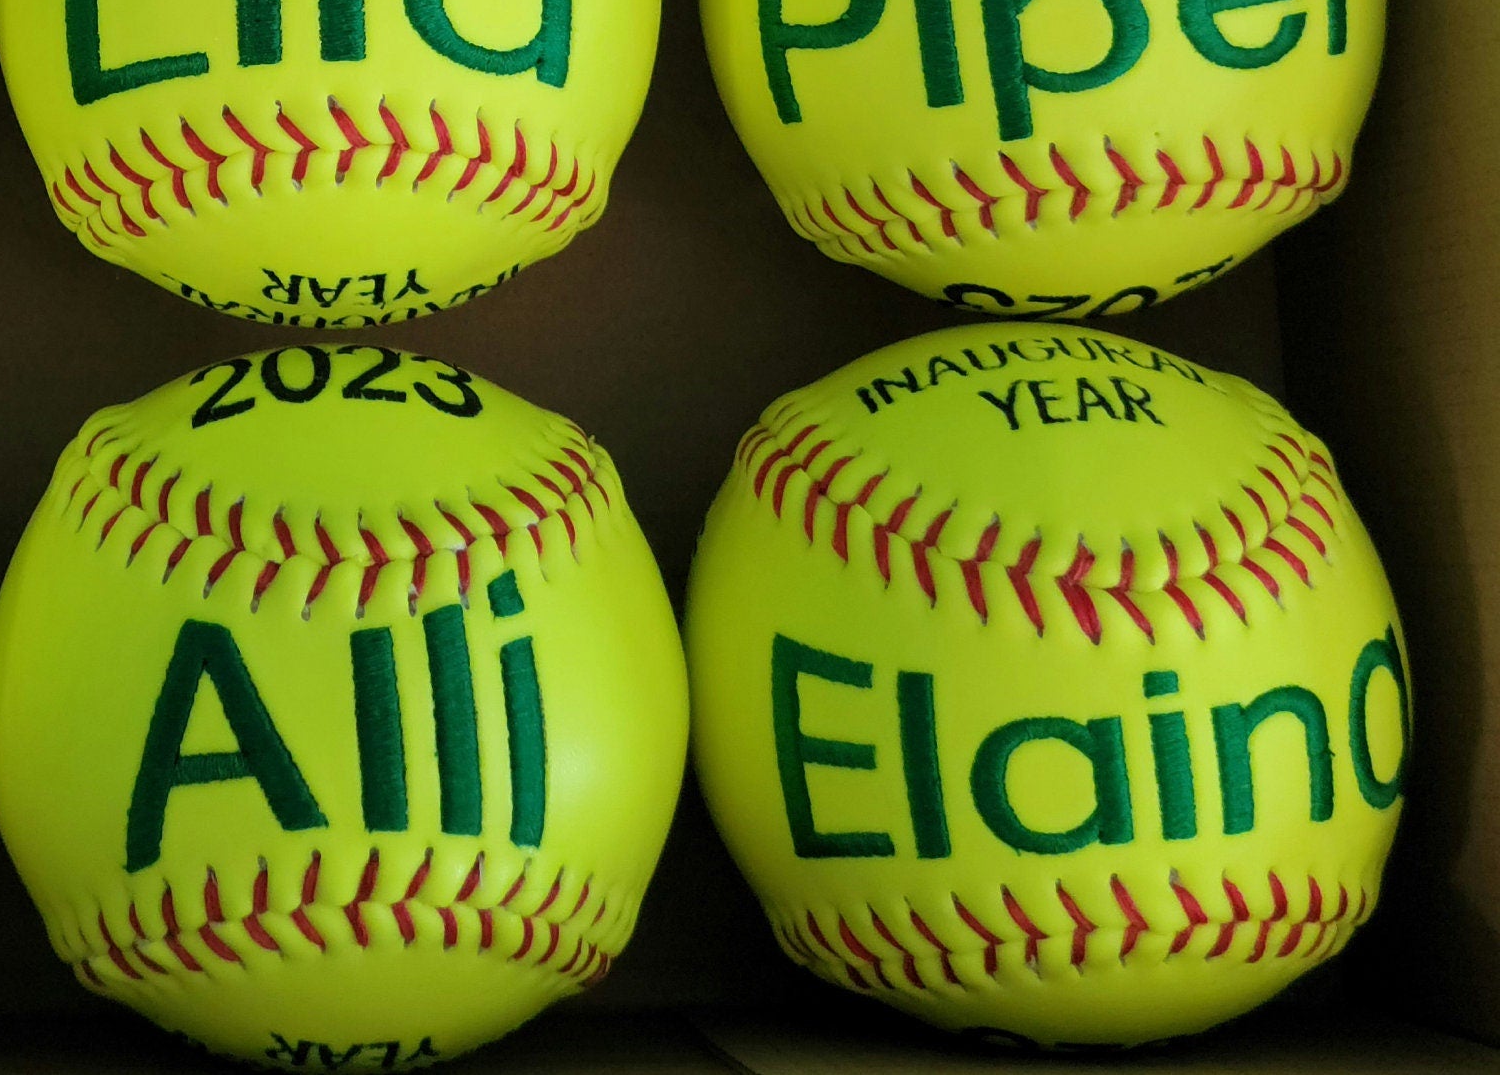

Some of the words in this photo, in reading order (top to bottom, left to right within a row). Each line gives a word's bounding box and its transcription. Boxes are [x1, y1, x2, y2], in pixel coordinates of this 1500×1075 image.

[261, 268, 431, 309] YEAR
[190, 345, 484, 429] 2023
[856, 337, 1229, 414] INAUGURAL
[978, 375, 1165, 431] YEAR
[125, 567, 547, 874] Alli
[770, 621, 1413, 861] Elaina
